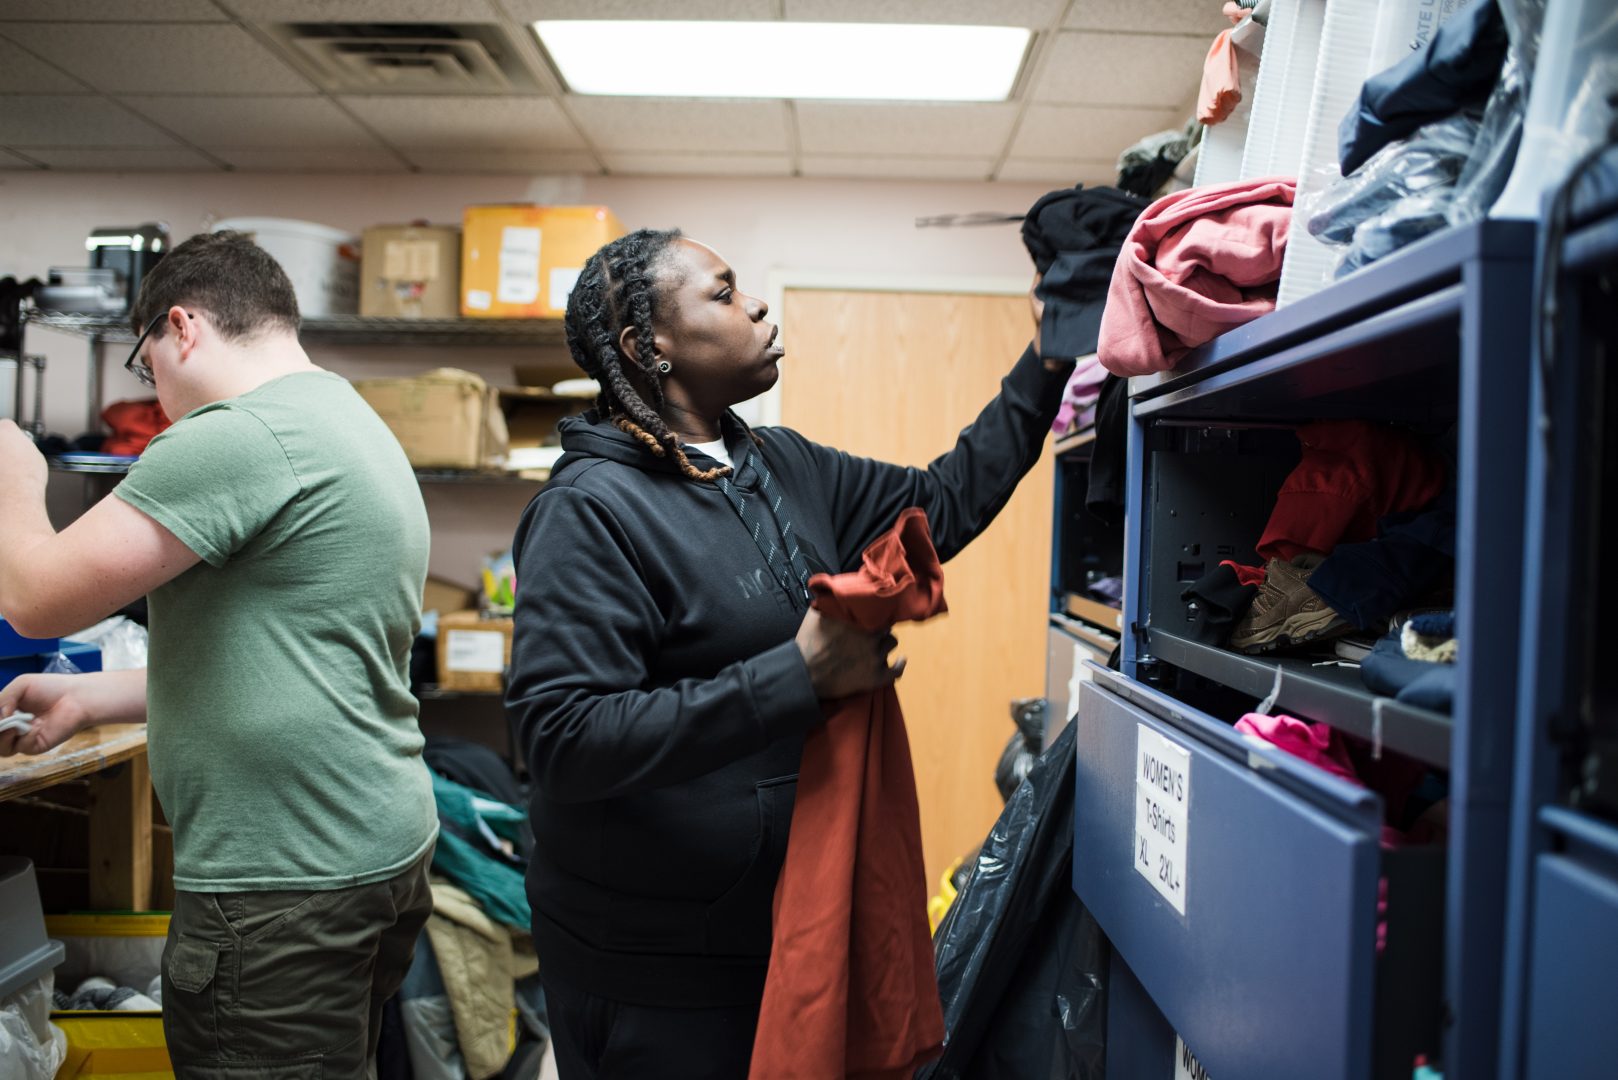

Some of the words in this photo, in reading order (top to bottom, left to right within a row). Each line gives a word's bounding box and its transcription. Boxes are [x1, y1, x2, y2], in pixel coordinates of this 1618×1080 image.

[1416, 9, 1432, 46] ATE
[1143, 752, 1183, 802] WOMEN'S
[1146, 797, 1176, 844] T-Shirts
[1140, 835, 1149, 867] XL
[1159, 853, 1180, 894] 2XL+
